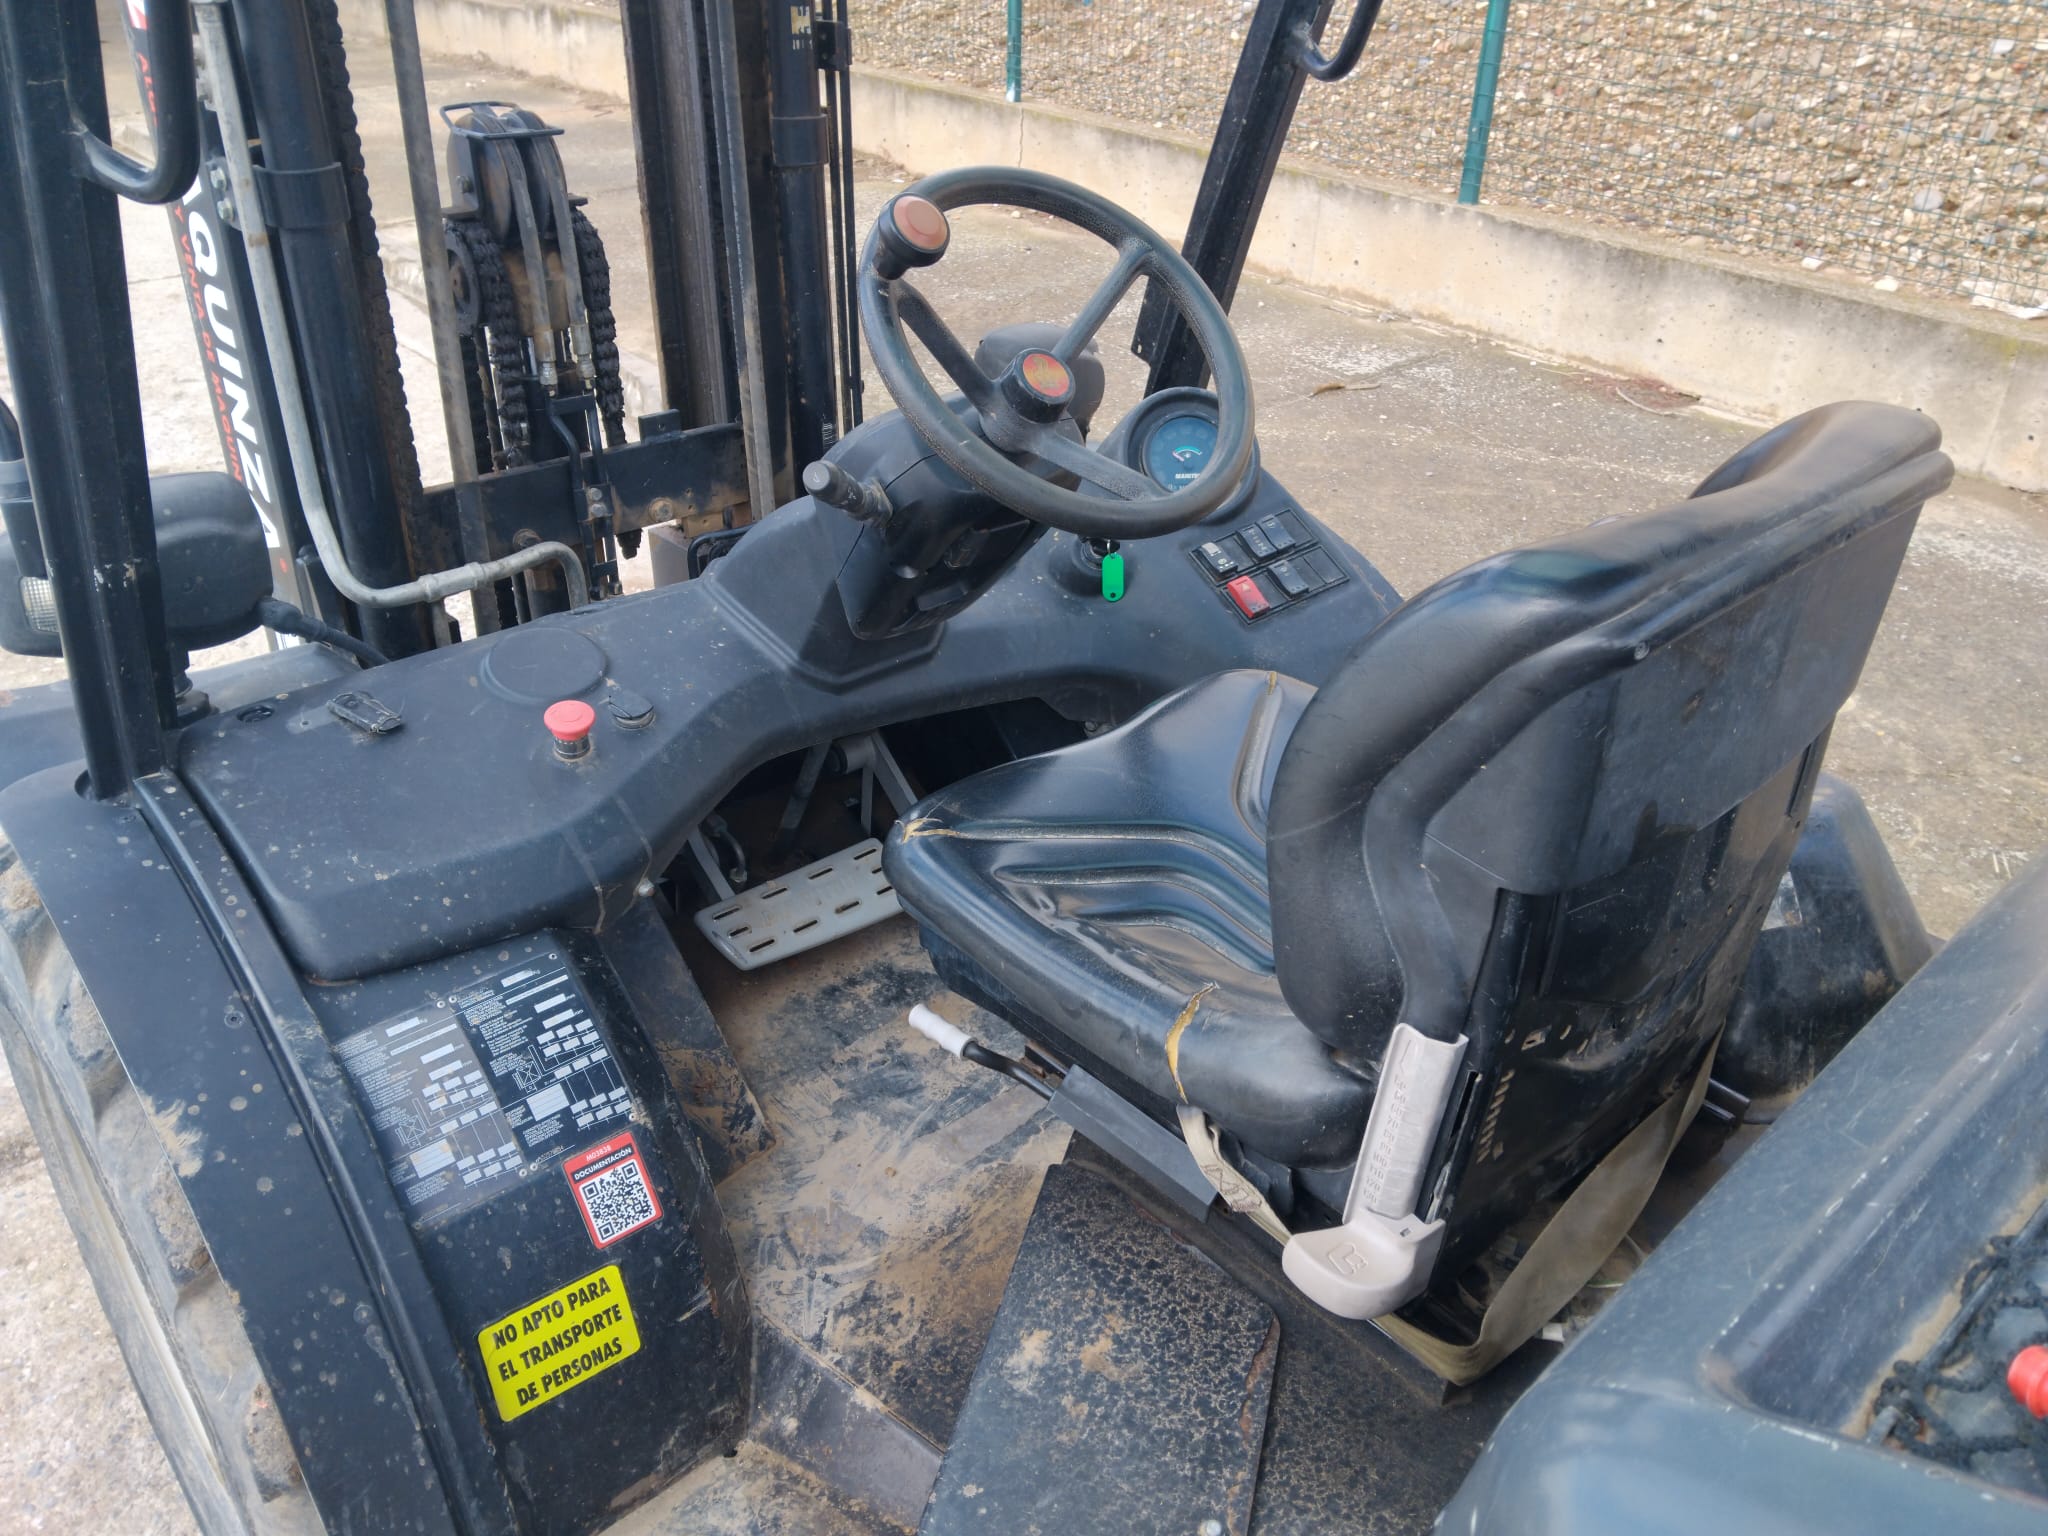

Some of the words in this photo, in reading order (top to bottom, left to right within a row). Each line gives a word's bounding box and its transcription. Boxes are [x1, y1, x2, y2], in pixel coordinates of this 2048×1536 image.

[181, 234, 205, 320] VENTA
[202, 331, 216, 364] DE
[211, 369, 245, 483] MAQUIN
[183, 175, 281, 548] QUINZA
[574, 1147, 632, 1180] DOCUMENTACIÓN
[492, 1324, 517, 1350] NO
[522, 1300, 564, 1336] APTO
[566, 1277, 611, 1311] PARA
[498, 1359, 518, 1382] EL
[519, 1303, 622, 1369] TRANSPORTE
[516, 1382, 539, 1406] DE
[541, 1337, 623, 1393] PERSONAS
